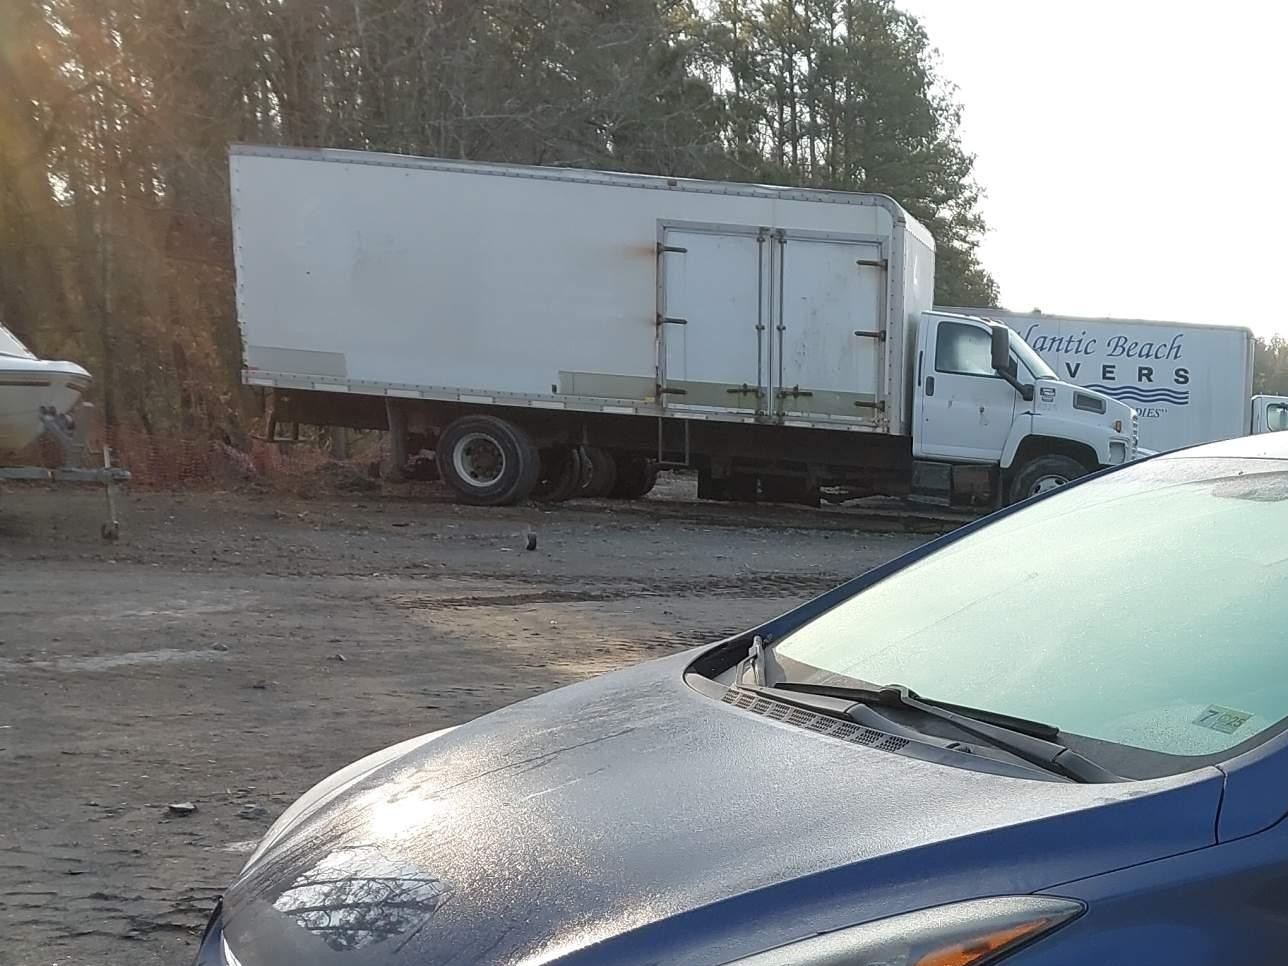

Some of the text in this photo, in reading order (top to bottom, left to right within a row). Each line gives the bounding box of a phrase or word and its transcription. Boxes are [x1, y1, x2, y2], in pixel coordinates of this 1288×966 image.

[1018, 324, 1185, 361] lantic Beach
[1065, 362, 1190, 385] VERS
